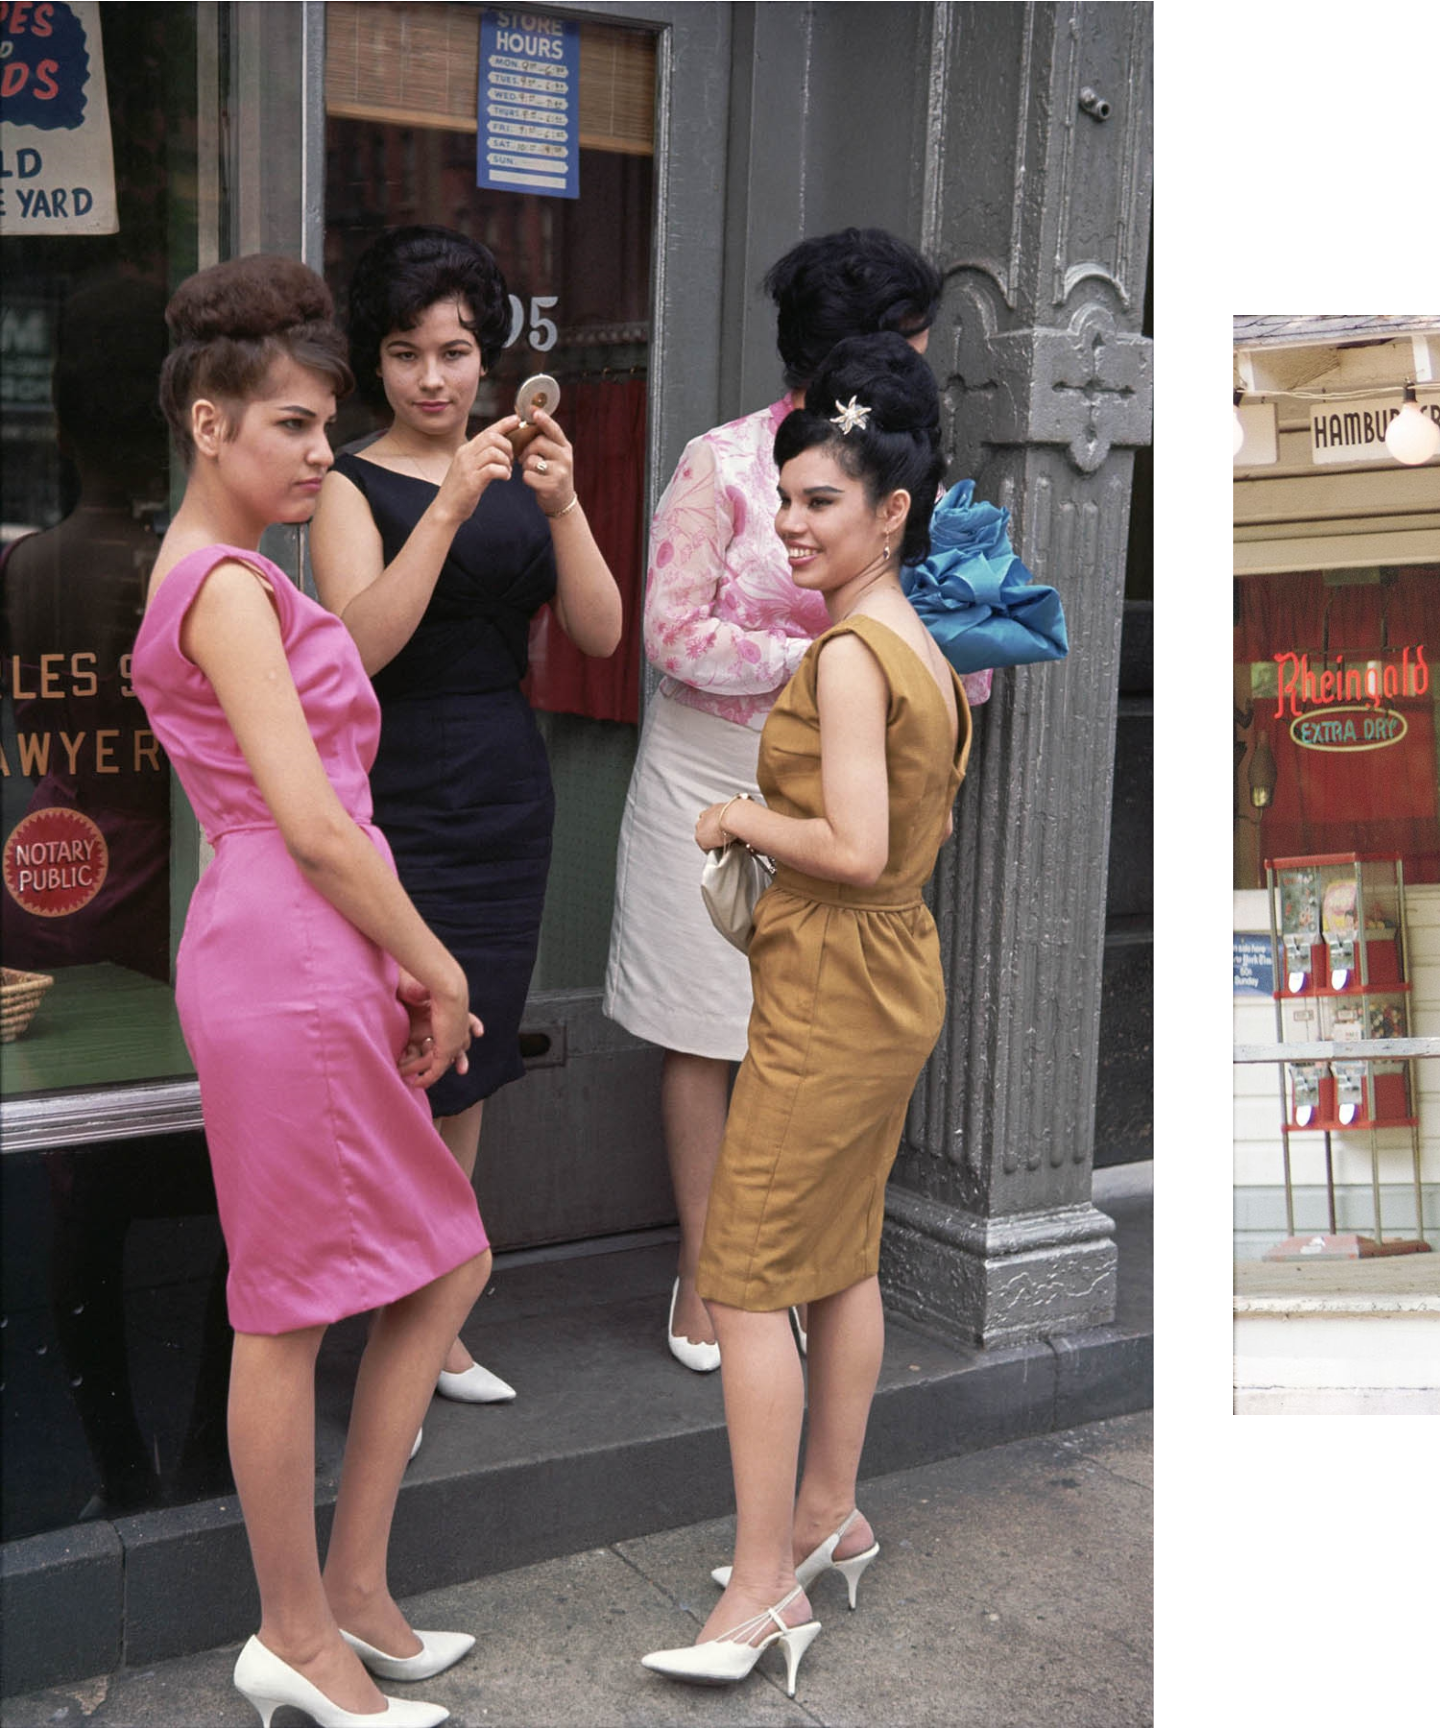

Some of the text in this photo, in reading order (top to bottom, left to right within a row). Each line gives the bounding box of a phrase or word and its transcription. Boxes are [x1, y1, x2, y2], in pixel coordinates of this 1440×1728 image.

[0, 2, 55, 37] ES
[497, 11, 564, 37] STORE
[496, 31, 564, 60] HOURS
[16, 187, 94, 219] YARD
[0, 652, 98, 699] LES
[1274, 645, 1430, 719] Rheingold
[1301, 717, 1398, 744] EXTRA DRY
[16, 839, 96, 867] NOTARY
[19, 865, 93, 892] PUBLIC
